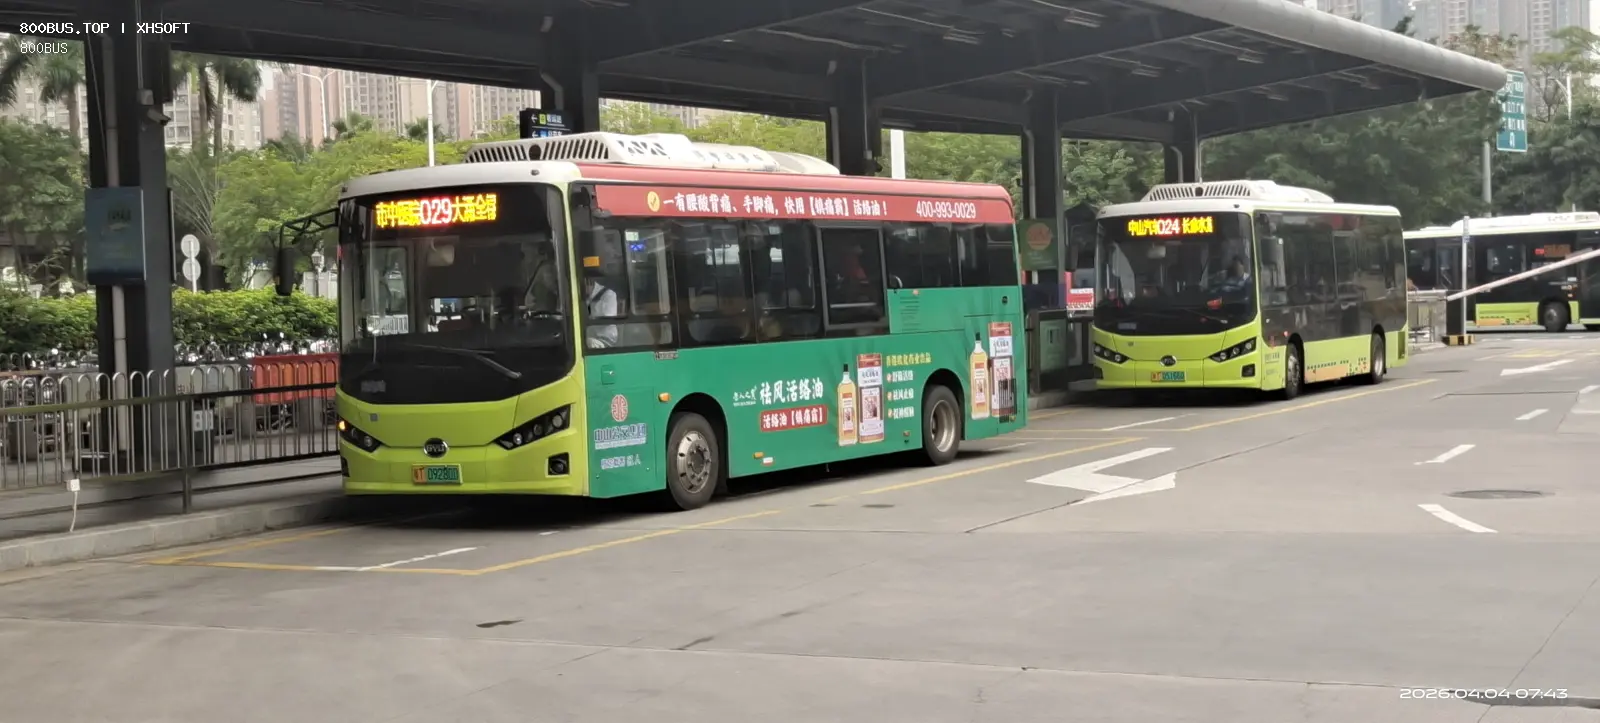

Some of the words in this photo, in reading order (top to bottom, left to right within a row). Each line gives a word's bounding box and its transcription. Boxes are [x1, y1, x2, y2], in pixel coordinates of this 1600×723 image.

[916, 200, 977, 219] 400-993-0029
[760, 377, 824, 406] 祛风活络油
